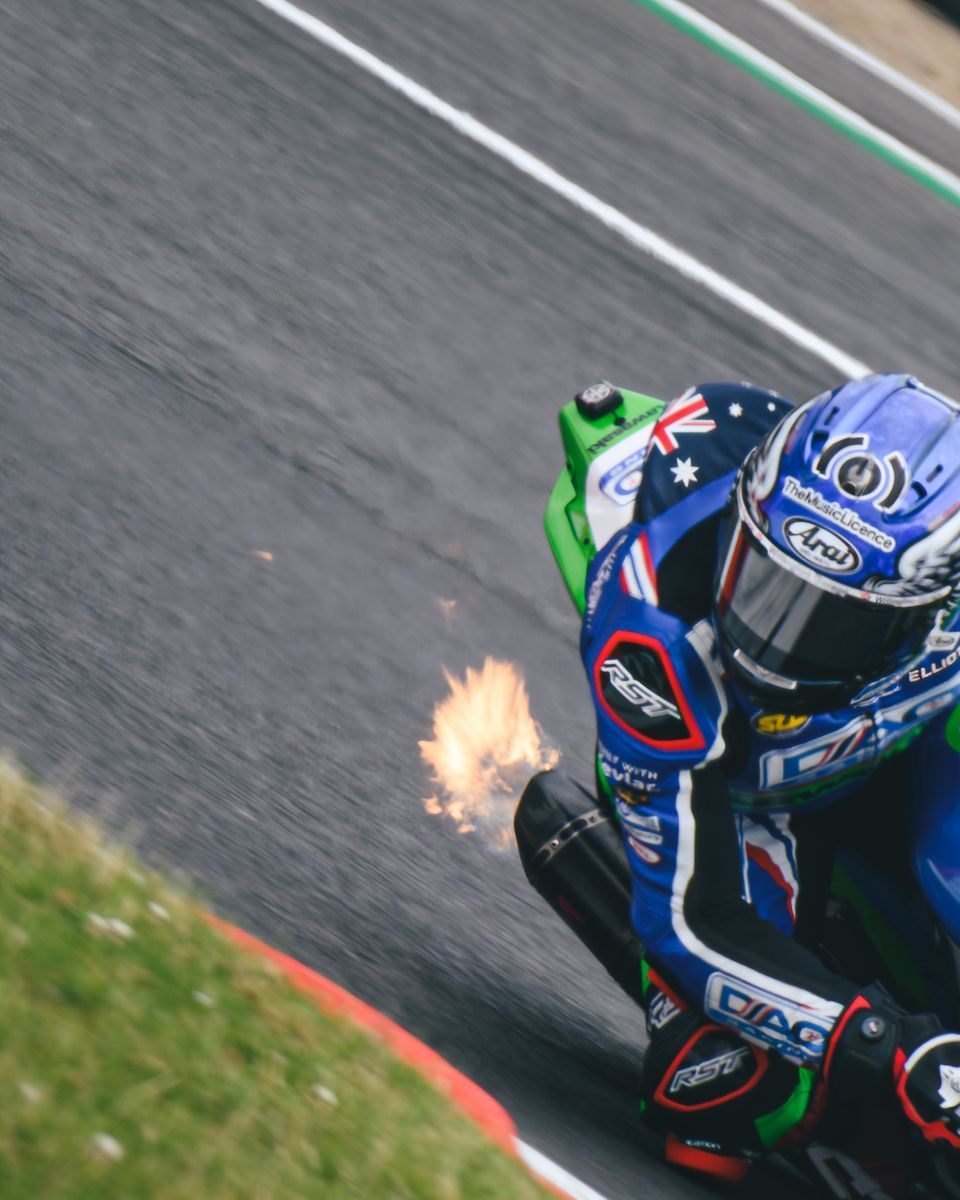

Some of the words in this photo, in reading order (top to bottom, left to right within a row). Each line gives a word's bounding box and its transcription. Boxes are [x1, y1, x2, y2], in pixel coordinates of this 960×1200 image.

[785, 478, 893, 550] TheMusicLicence
[786, 525, 851, 566] Arai
[601, 658, 682, 720] RST
[669, 1046, 751, 1093] RST
